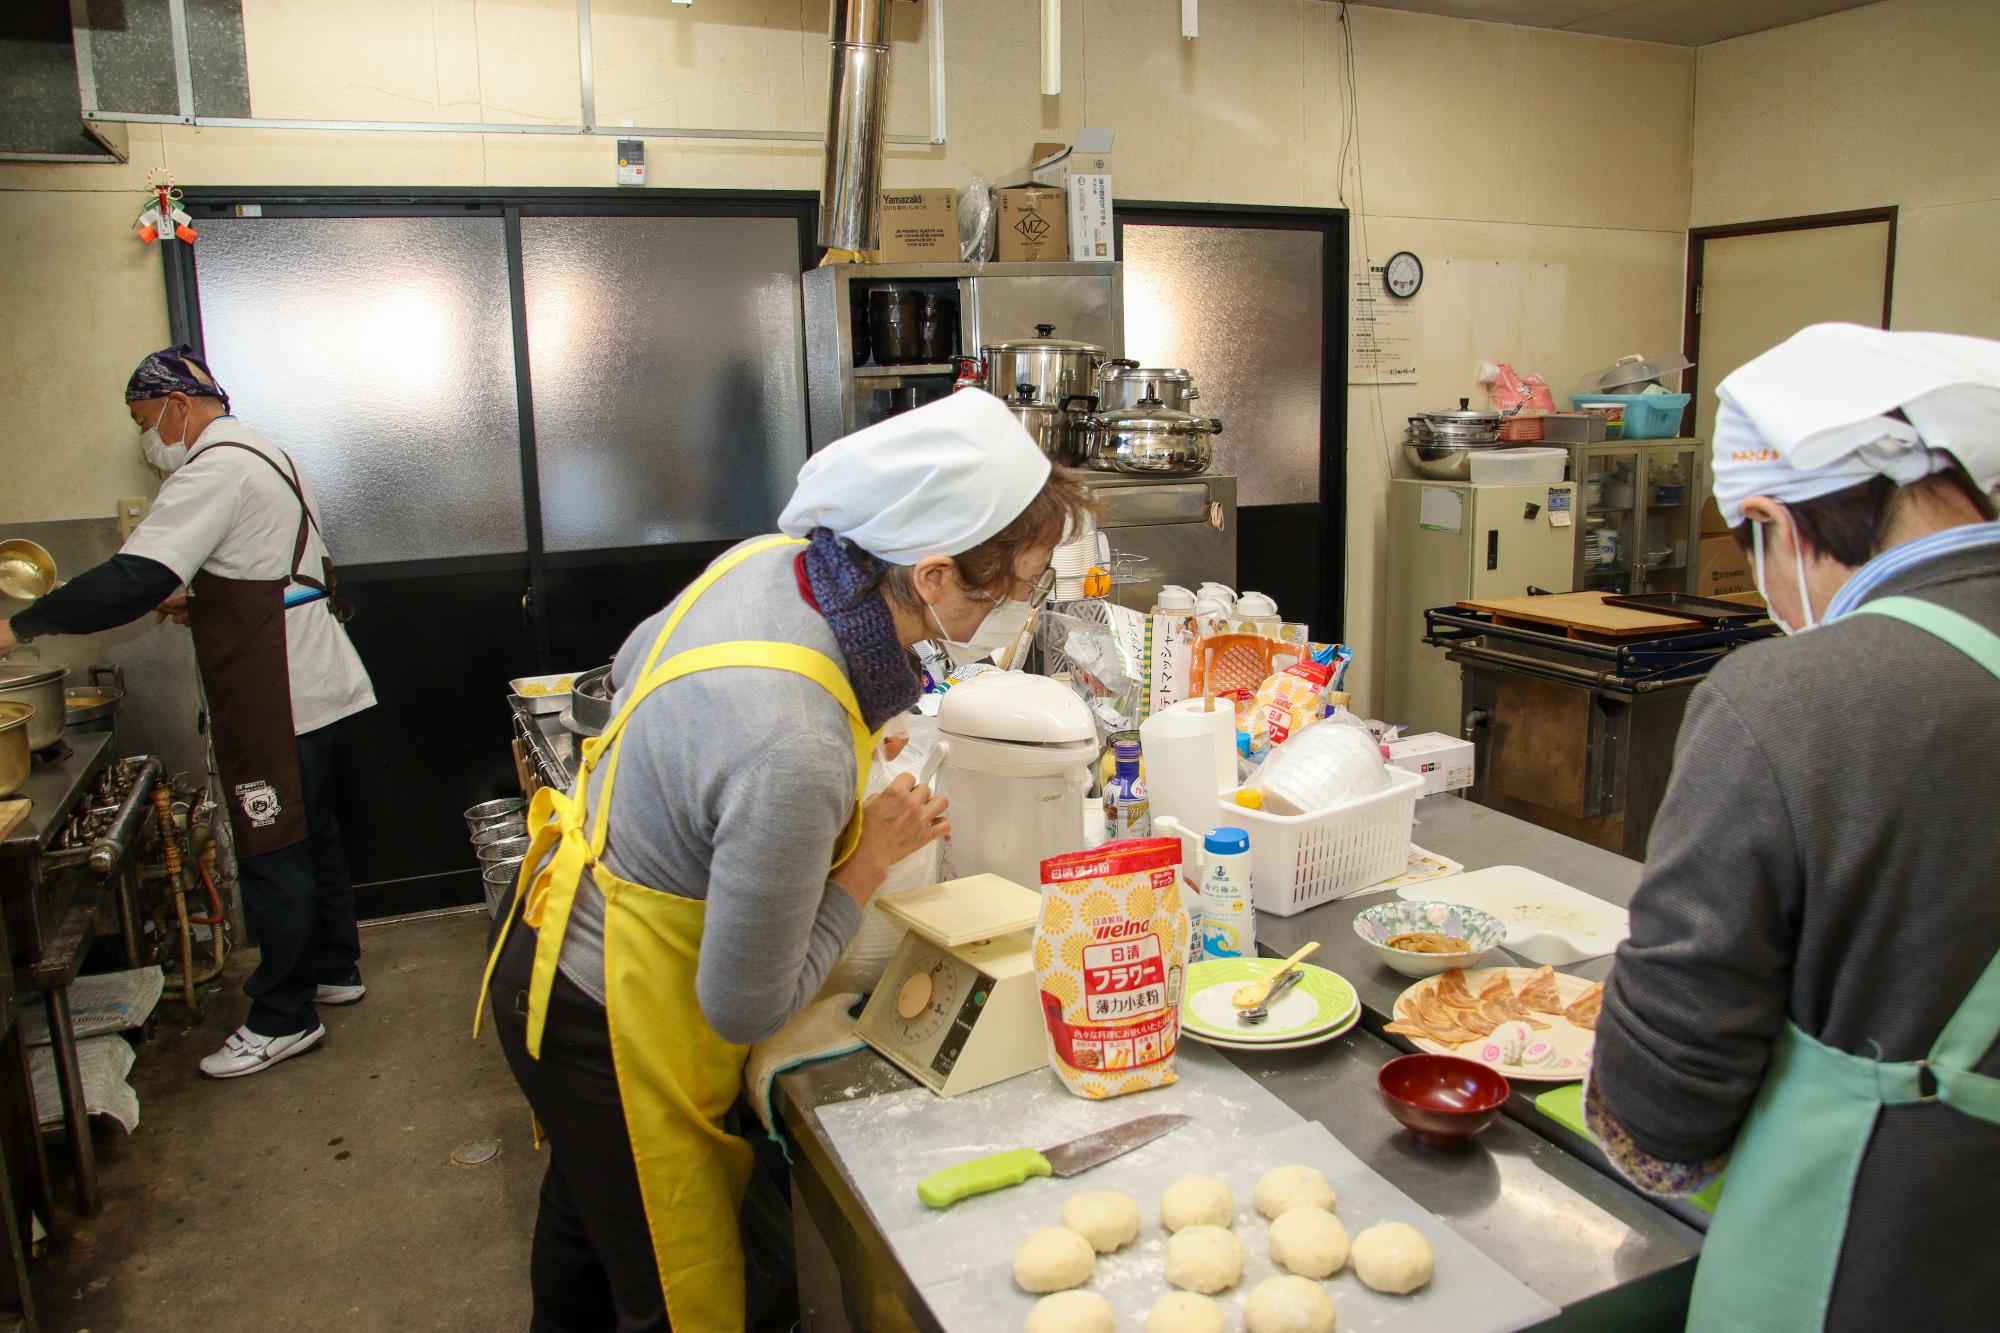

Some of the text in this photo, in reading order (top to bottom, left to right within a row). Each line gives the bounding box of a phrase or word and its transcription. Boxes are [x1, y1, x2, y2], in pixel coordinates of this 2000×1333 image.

[883, 194, 922, 204] Yamazaki
[1022, 219, 1042, 234] MZ
[1157, 622, 1174, 712] テトマッシャー
[1111, 944, 1141, 962] 日清
[1092, 964, 1157, 991] フラワー
[1095, 990, 1160, 1015] 薄力小麦粉
